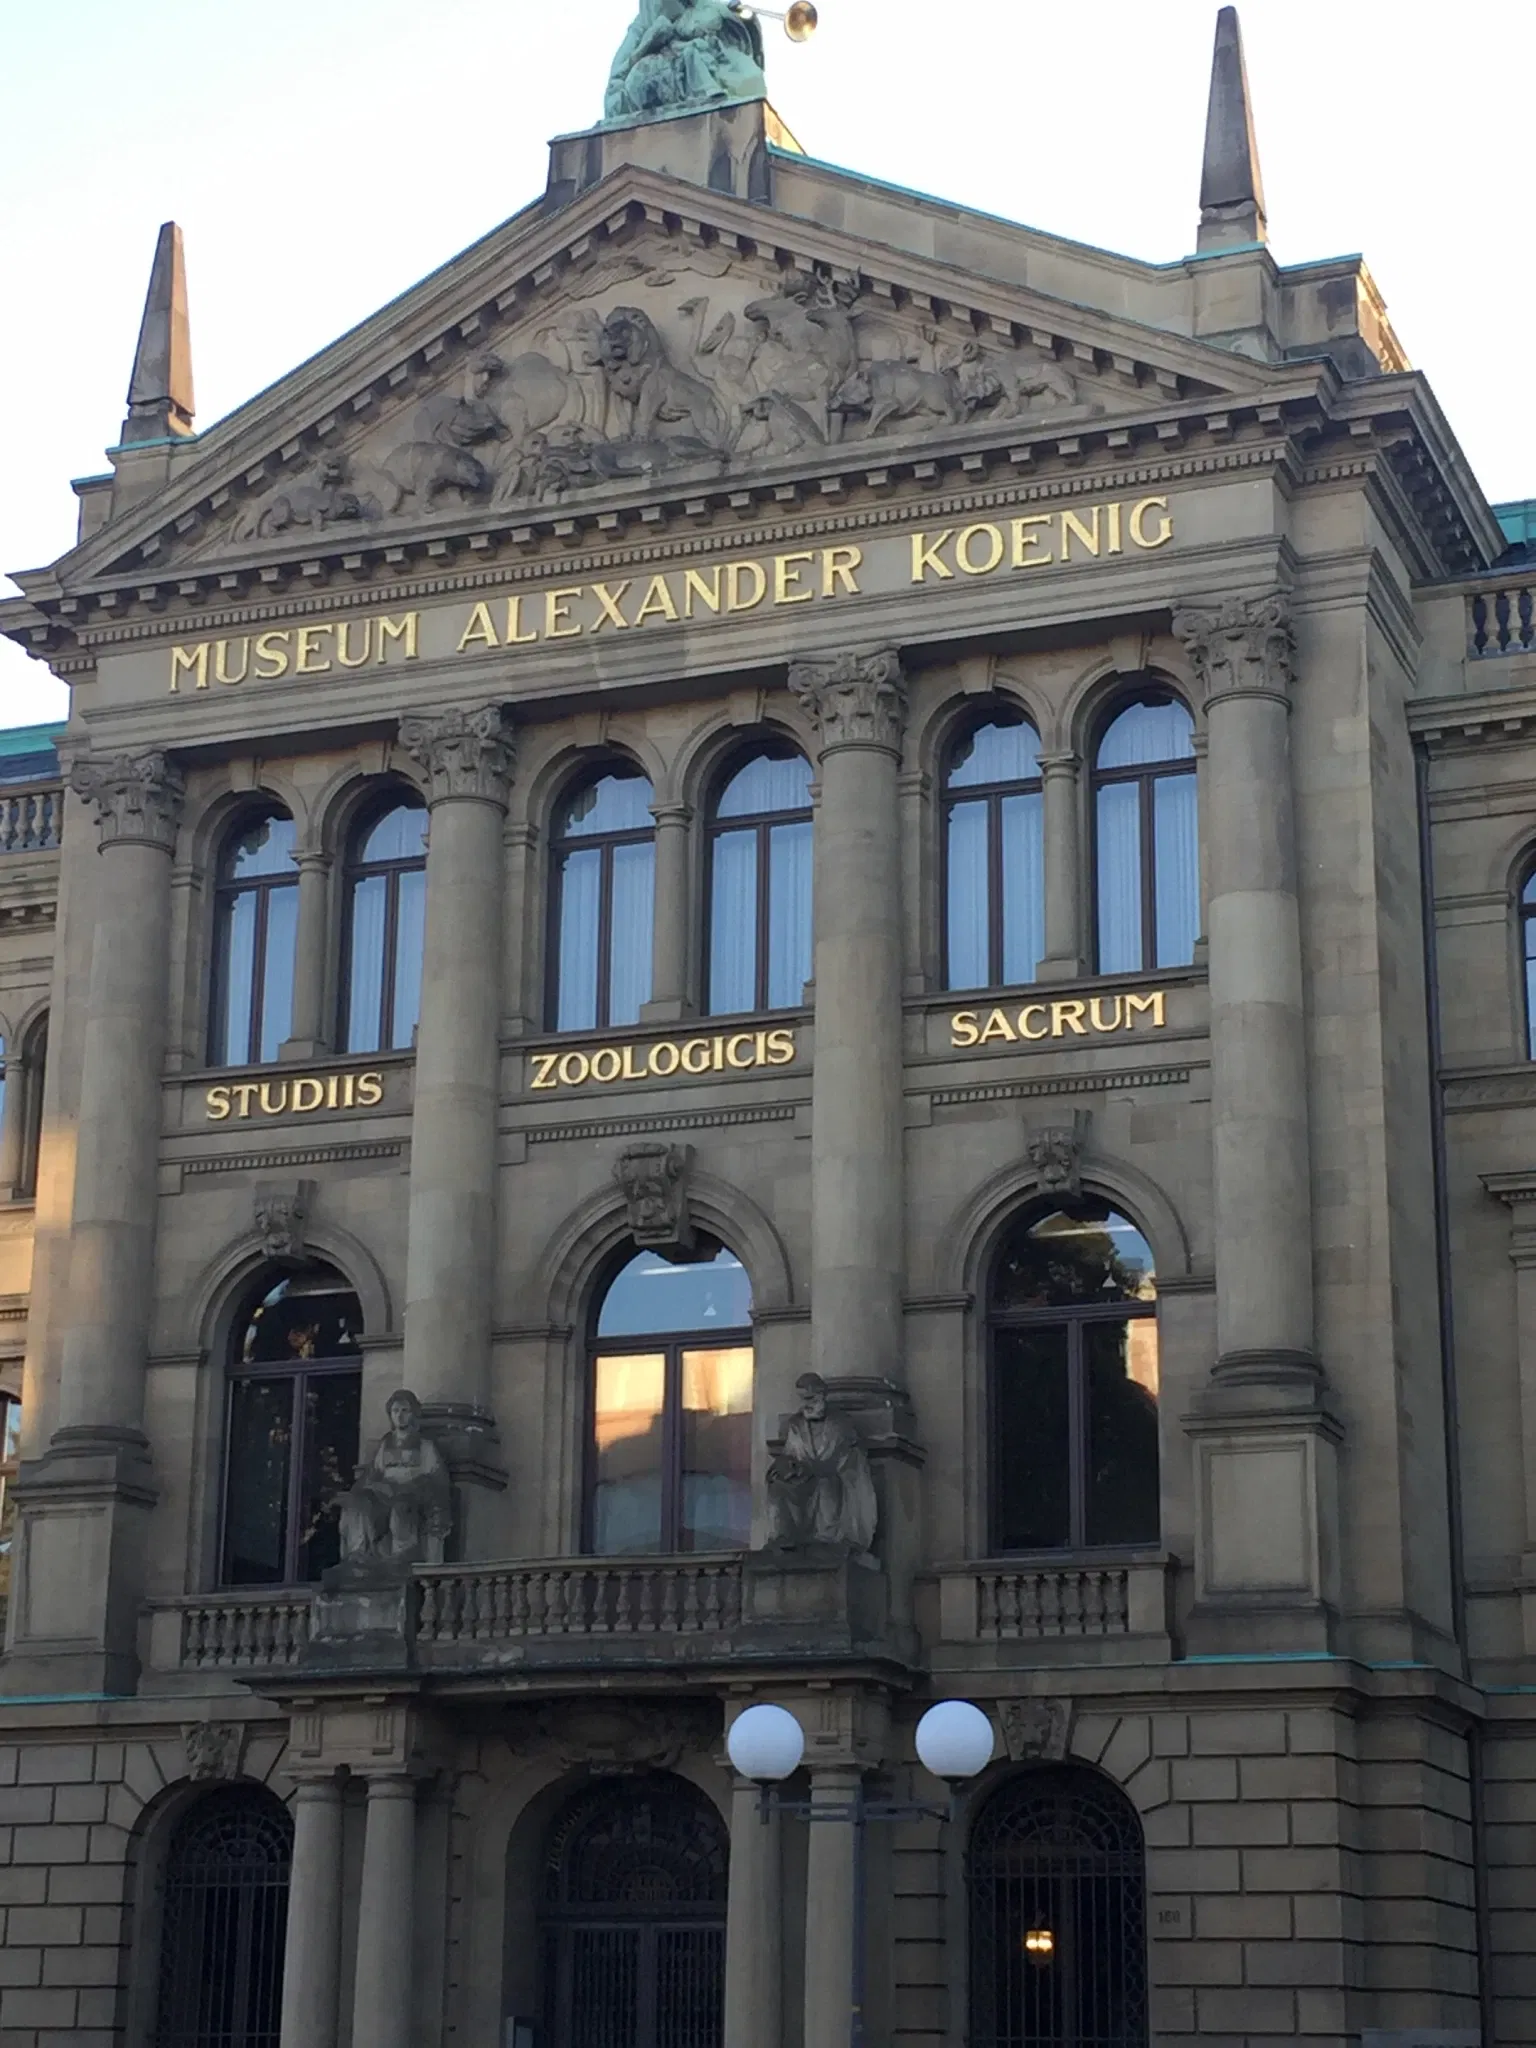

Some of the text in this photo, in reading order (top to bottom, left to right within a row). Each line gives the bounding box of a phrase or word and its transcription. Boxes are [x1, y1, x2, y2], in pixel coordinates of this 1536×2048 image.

[169, 496, 1173, 692] MUSEUM ALEXANDER KOENIG
[206, 991, 1166, 1121] STUDIIS ZOOLOGICIS SACRUM
